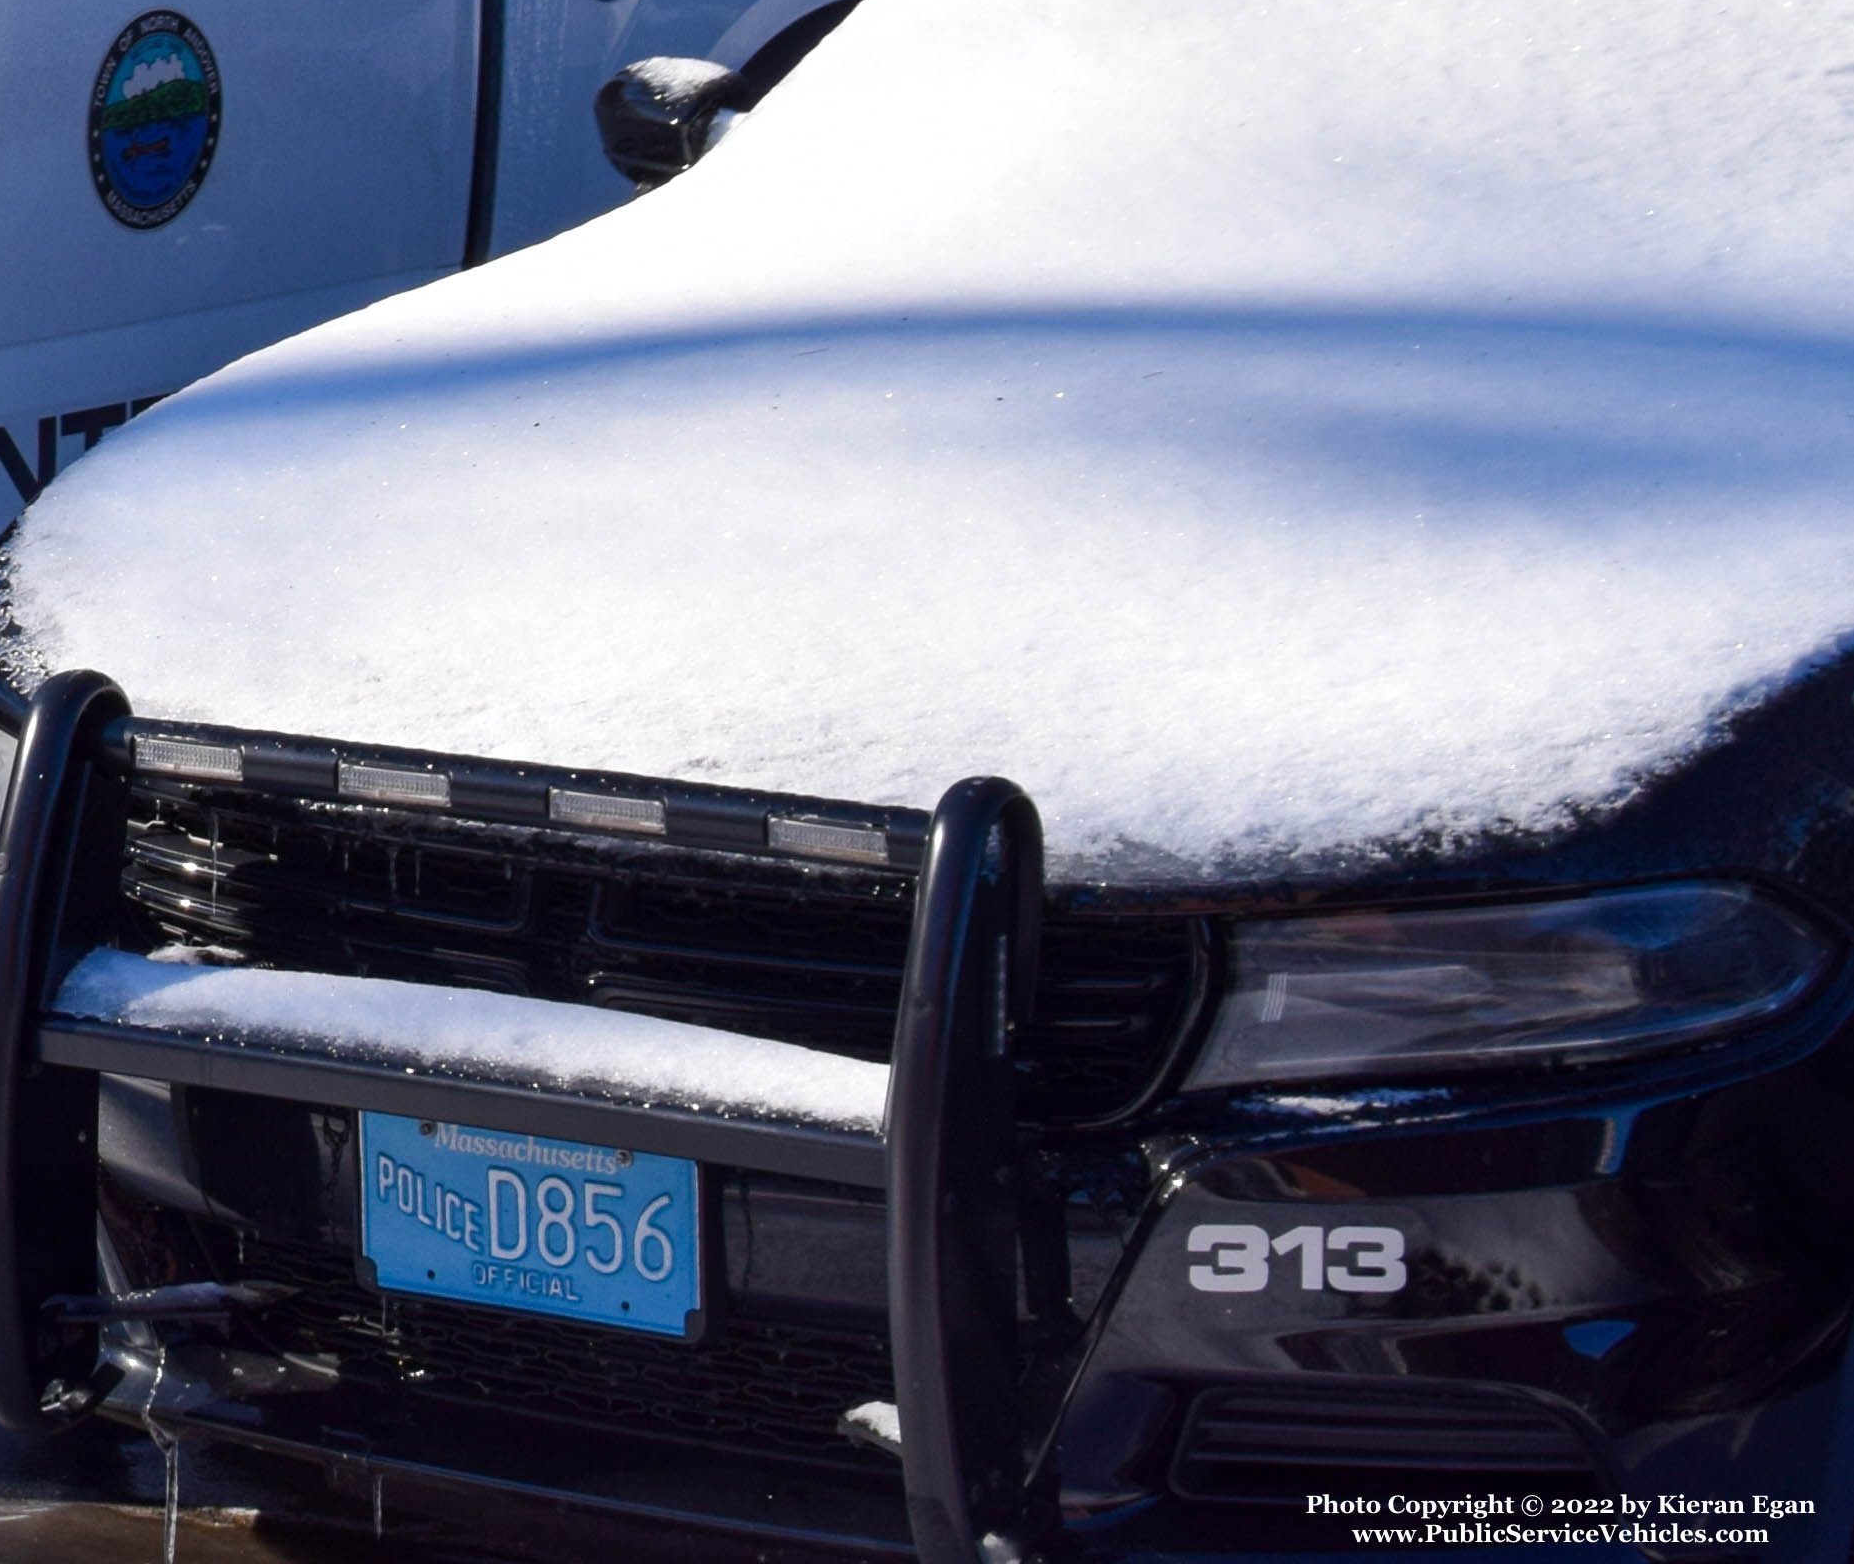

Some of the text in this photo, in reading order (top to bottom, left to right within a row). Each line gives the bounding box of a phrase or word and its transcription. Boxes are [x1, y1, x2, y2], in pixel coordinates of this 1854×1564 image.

[434, 1123, 618, 1176] Massachusetts
[377, 1154, 674, 1283] POLICE D856
[473, 1263, 581, 1301] OFFICIAL
[1187, 1224, 1407, 1293] 313
